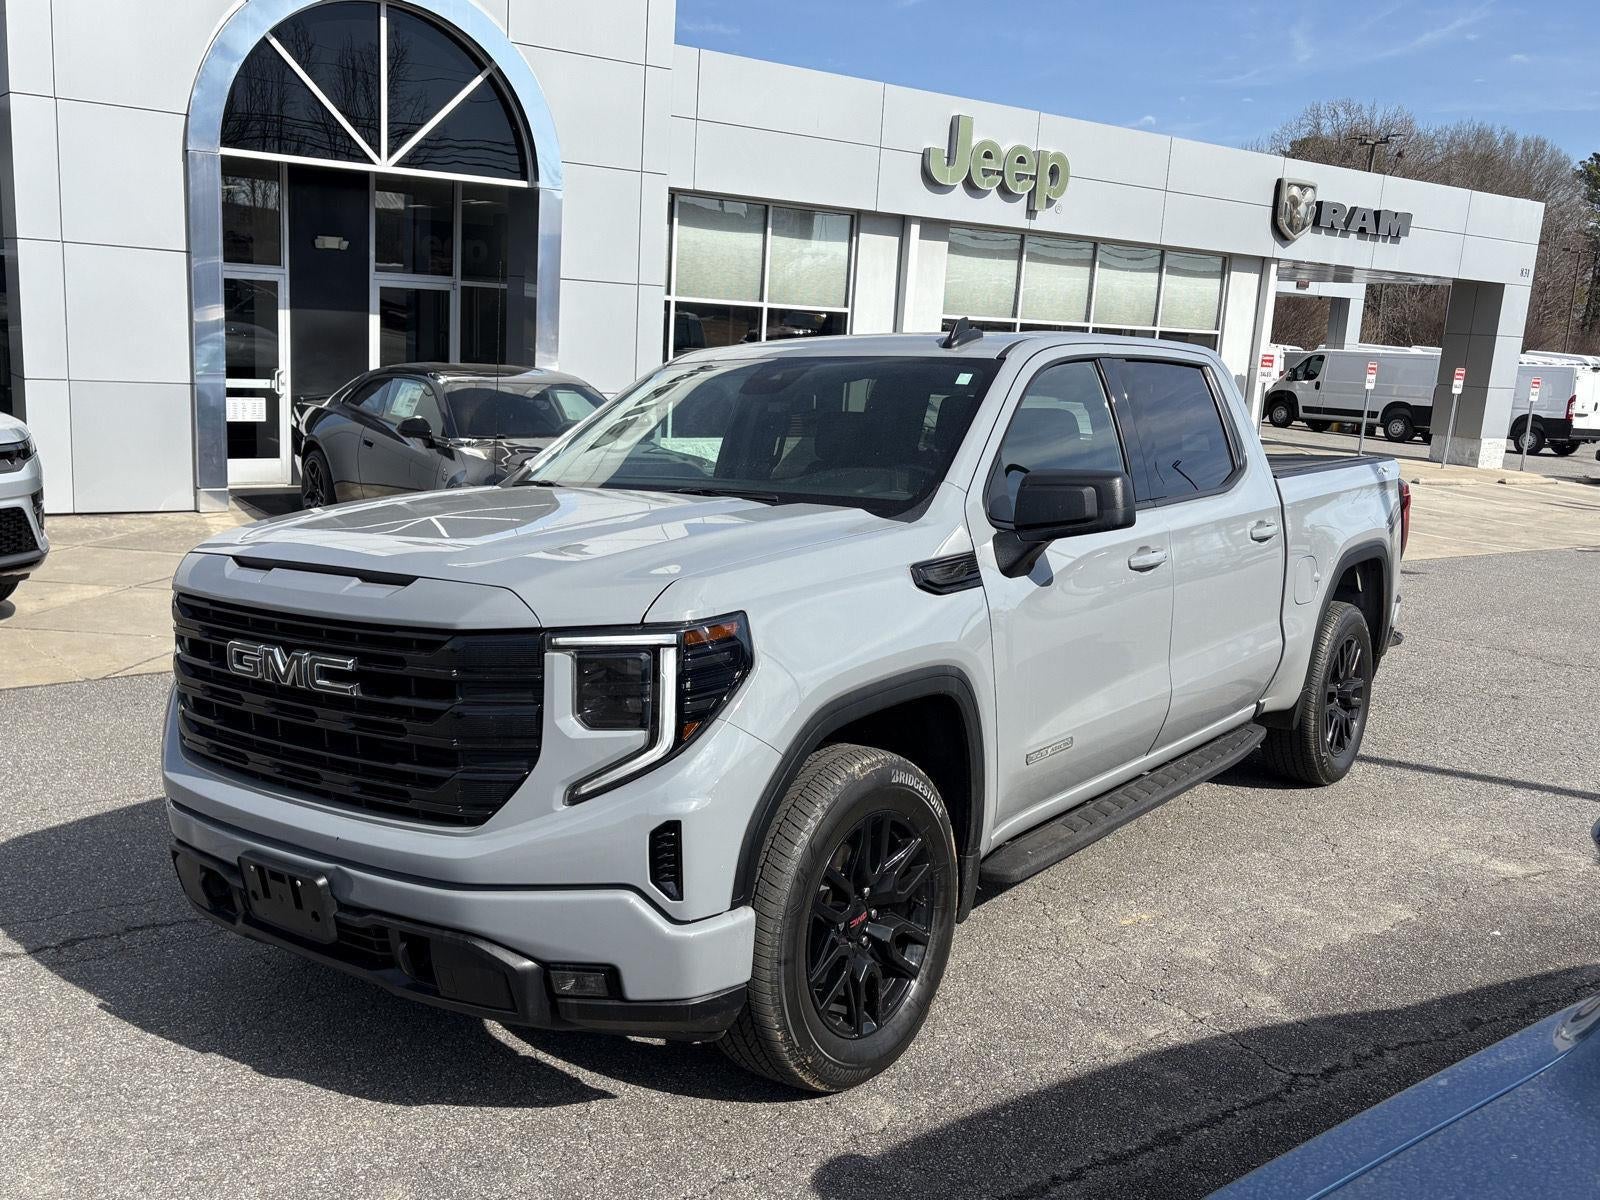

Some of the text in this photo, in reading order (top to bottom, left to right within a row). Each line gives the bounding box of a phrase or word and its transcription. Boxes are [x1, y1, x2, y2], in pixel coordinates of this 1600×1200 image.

[922, 114, 1071, 212] Jeep
[1313, 200, 1413, 240] RAM
[227, 640, 361, 697] GMC
[891, 769, 944, 818] BRIDGESTONE
[850, 911, 868, 928] GMC
